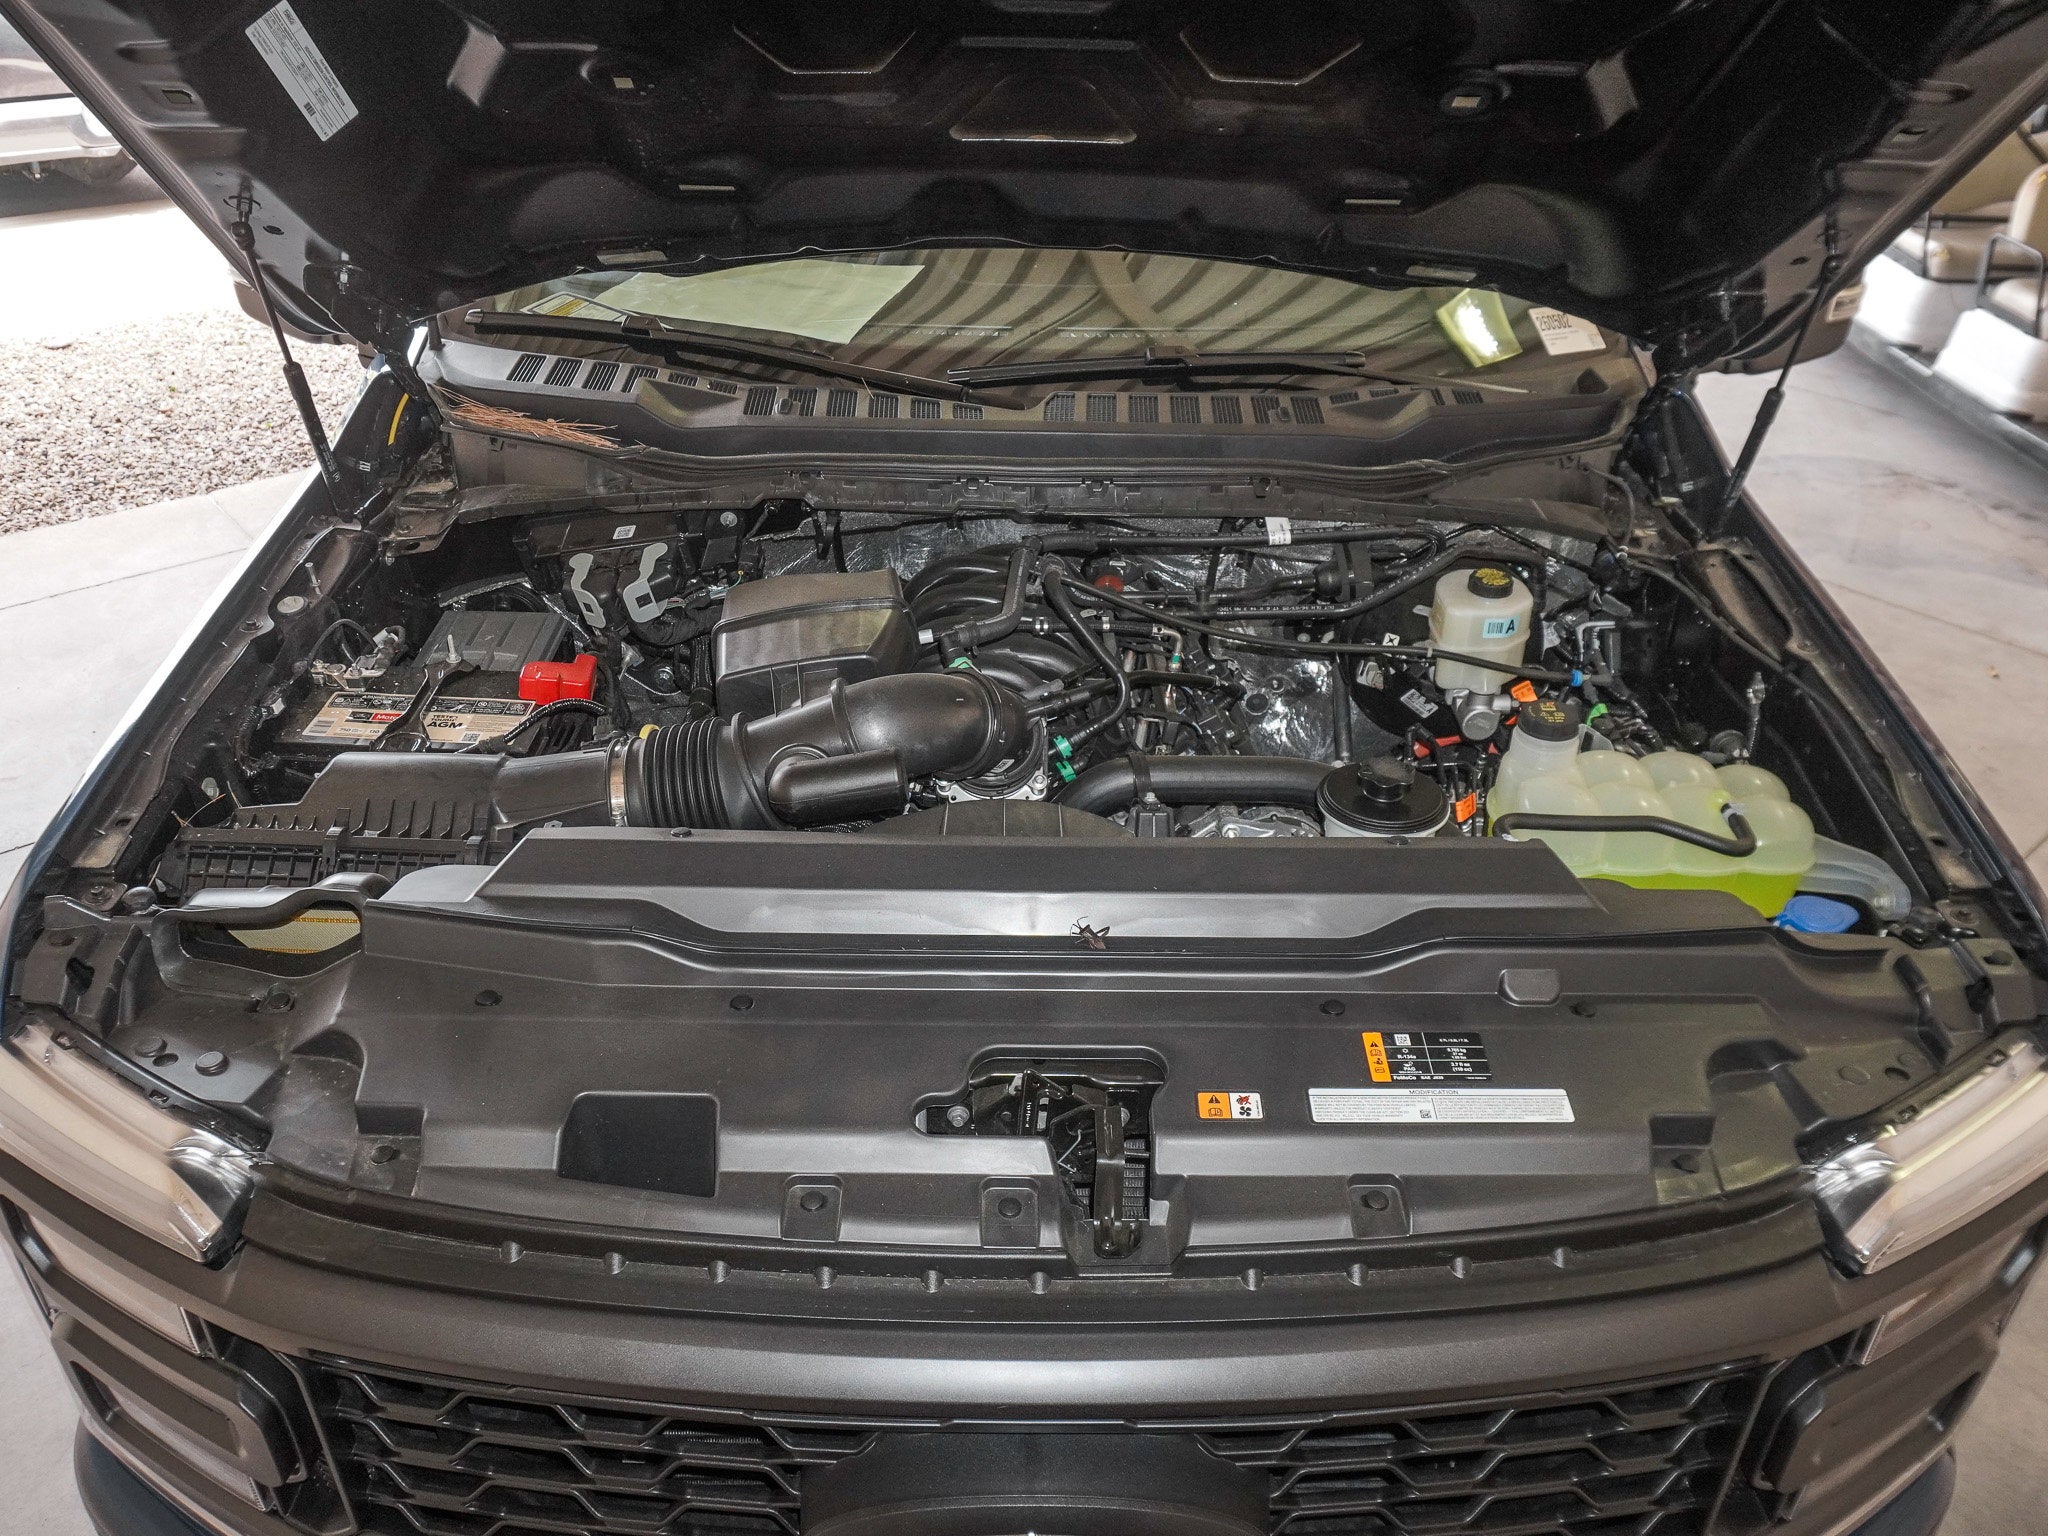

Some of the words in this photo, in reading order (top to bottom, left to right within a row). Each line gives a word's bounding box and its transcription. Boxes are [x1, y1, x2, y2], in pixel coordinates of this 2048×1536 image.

[1536, 313, 1573, 331] 260502
[1505, 619, 1516, 634] A
[426, 721, 463, 729] AGM
